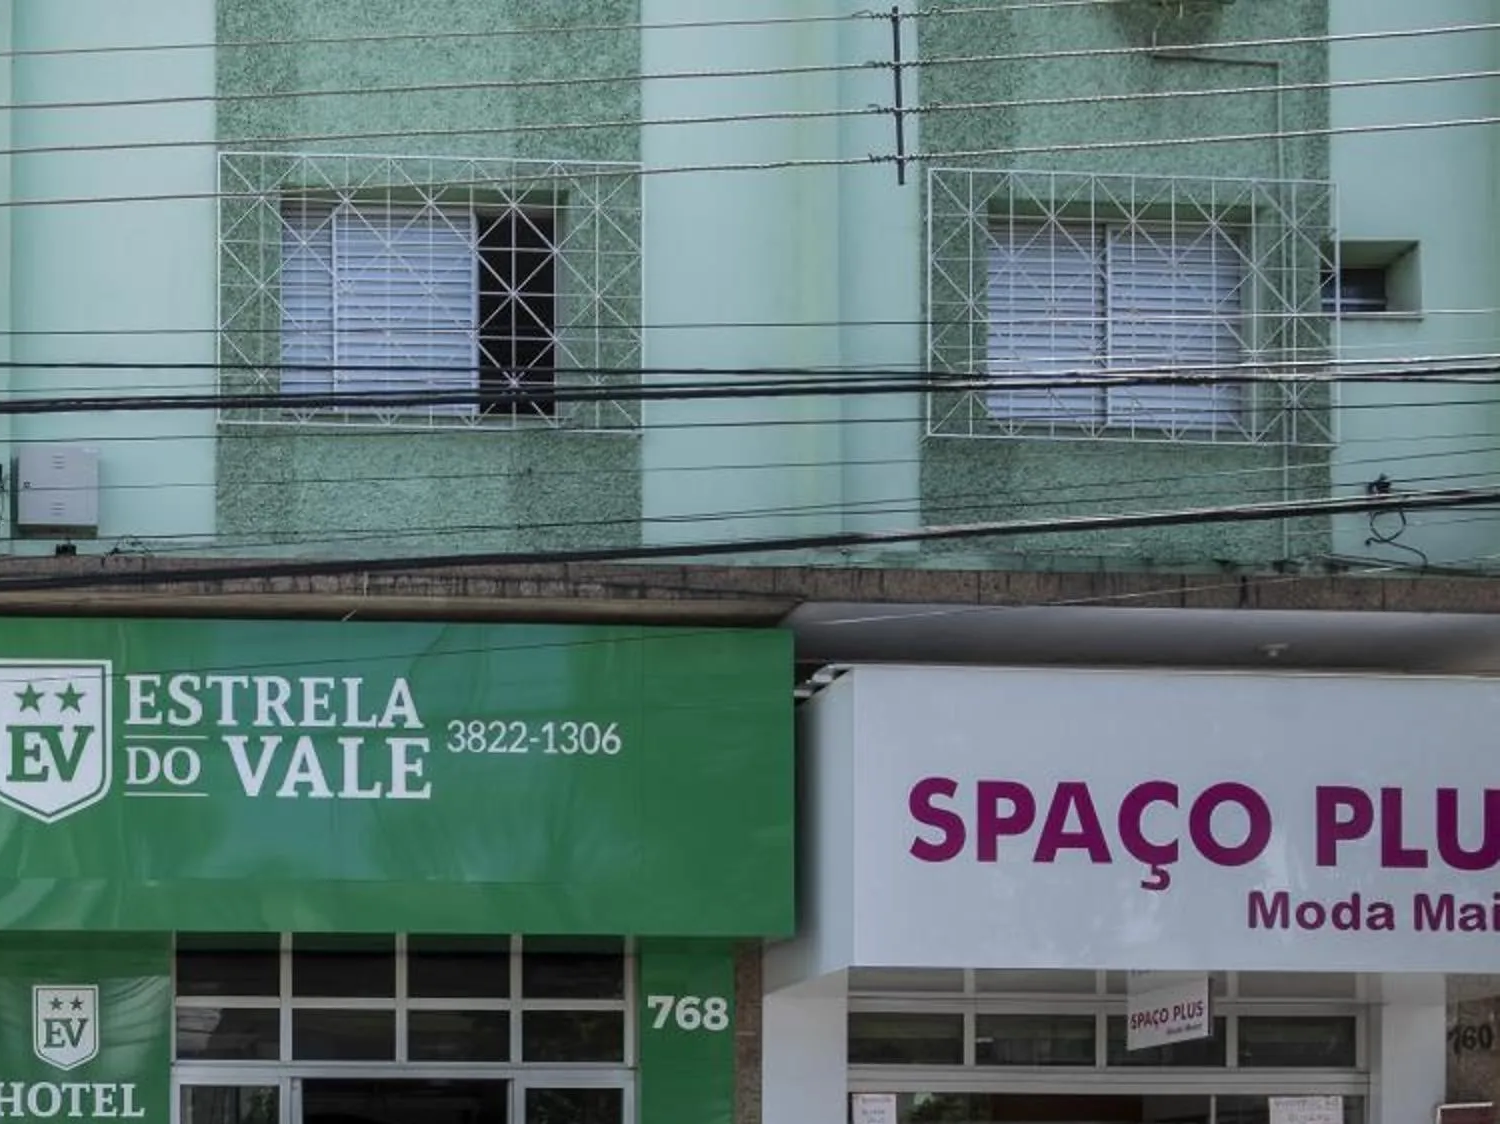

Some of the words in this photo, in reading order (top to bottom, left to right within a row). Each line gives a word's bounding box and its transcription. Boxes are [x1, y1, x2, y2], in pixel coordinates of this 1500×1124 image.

[123, 673, 425, 729] ESTRELA
[5, 725, 95, 784] EV
[446, 719, 622, 756] 3822-1306
[123, 746, 201, 786] DO
[221, 735, 432, 800] VALE
[908, 777, 1273, 890] SPAÇO
[1315, 785, 1500, 871] PLU
[1247, 891, 1396, 931] Moda
[647, 994, 730, 1031] 768
[1130, 1007, 1169, 1030] SPAÇO
[1173, 1000, 1204, 1021] PLUS
[42, 1017, 90, 1049] EV
